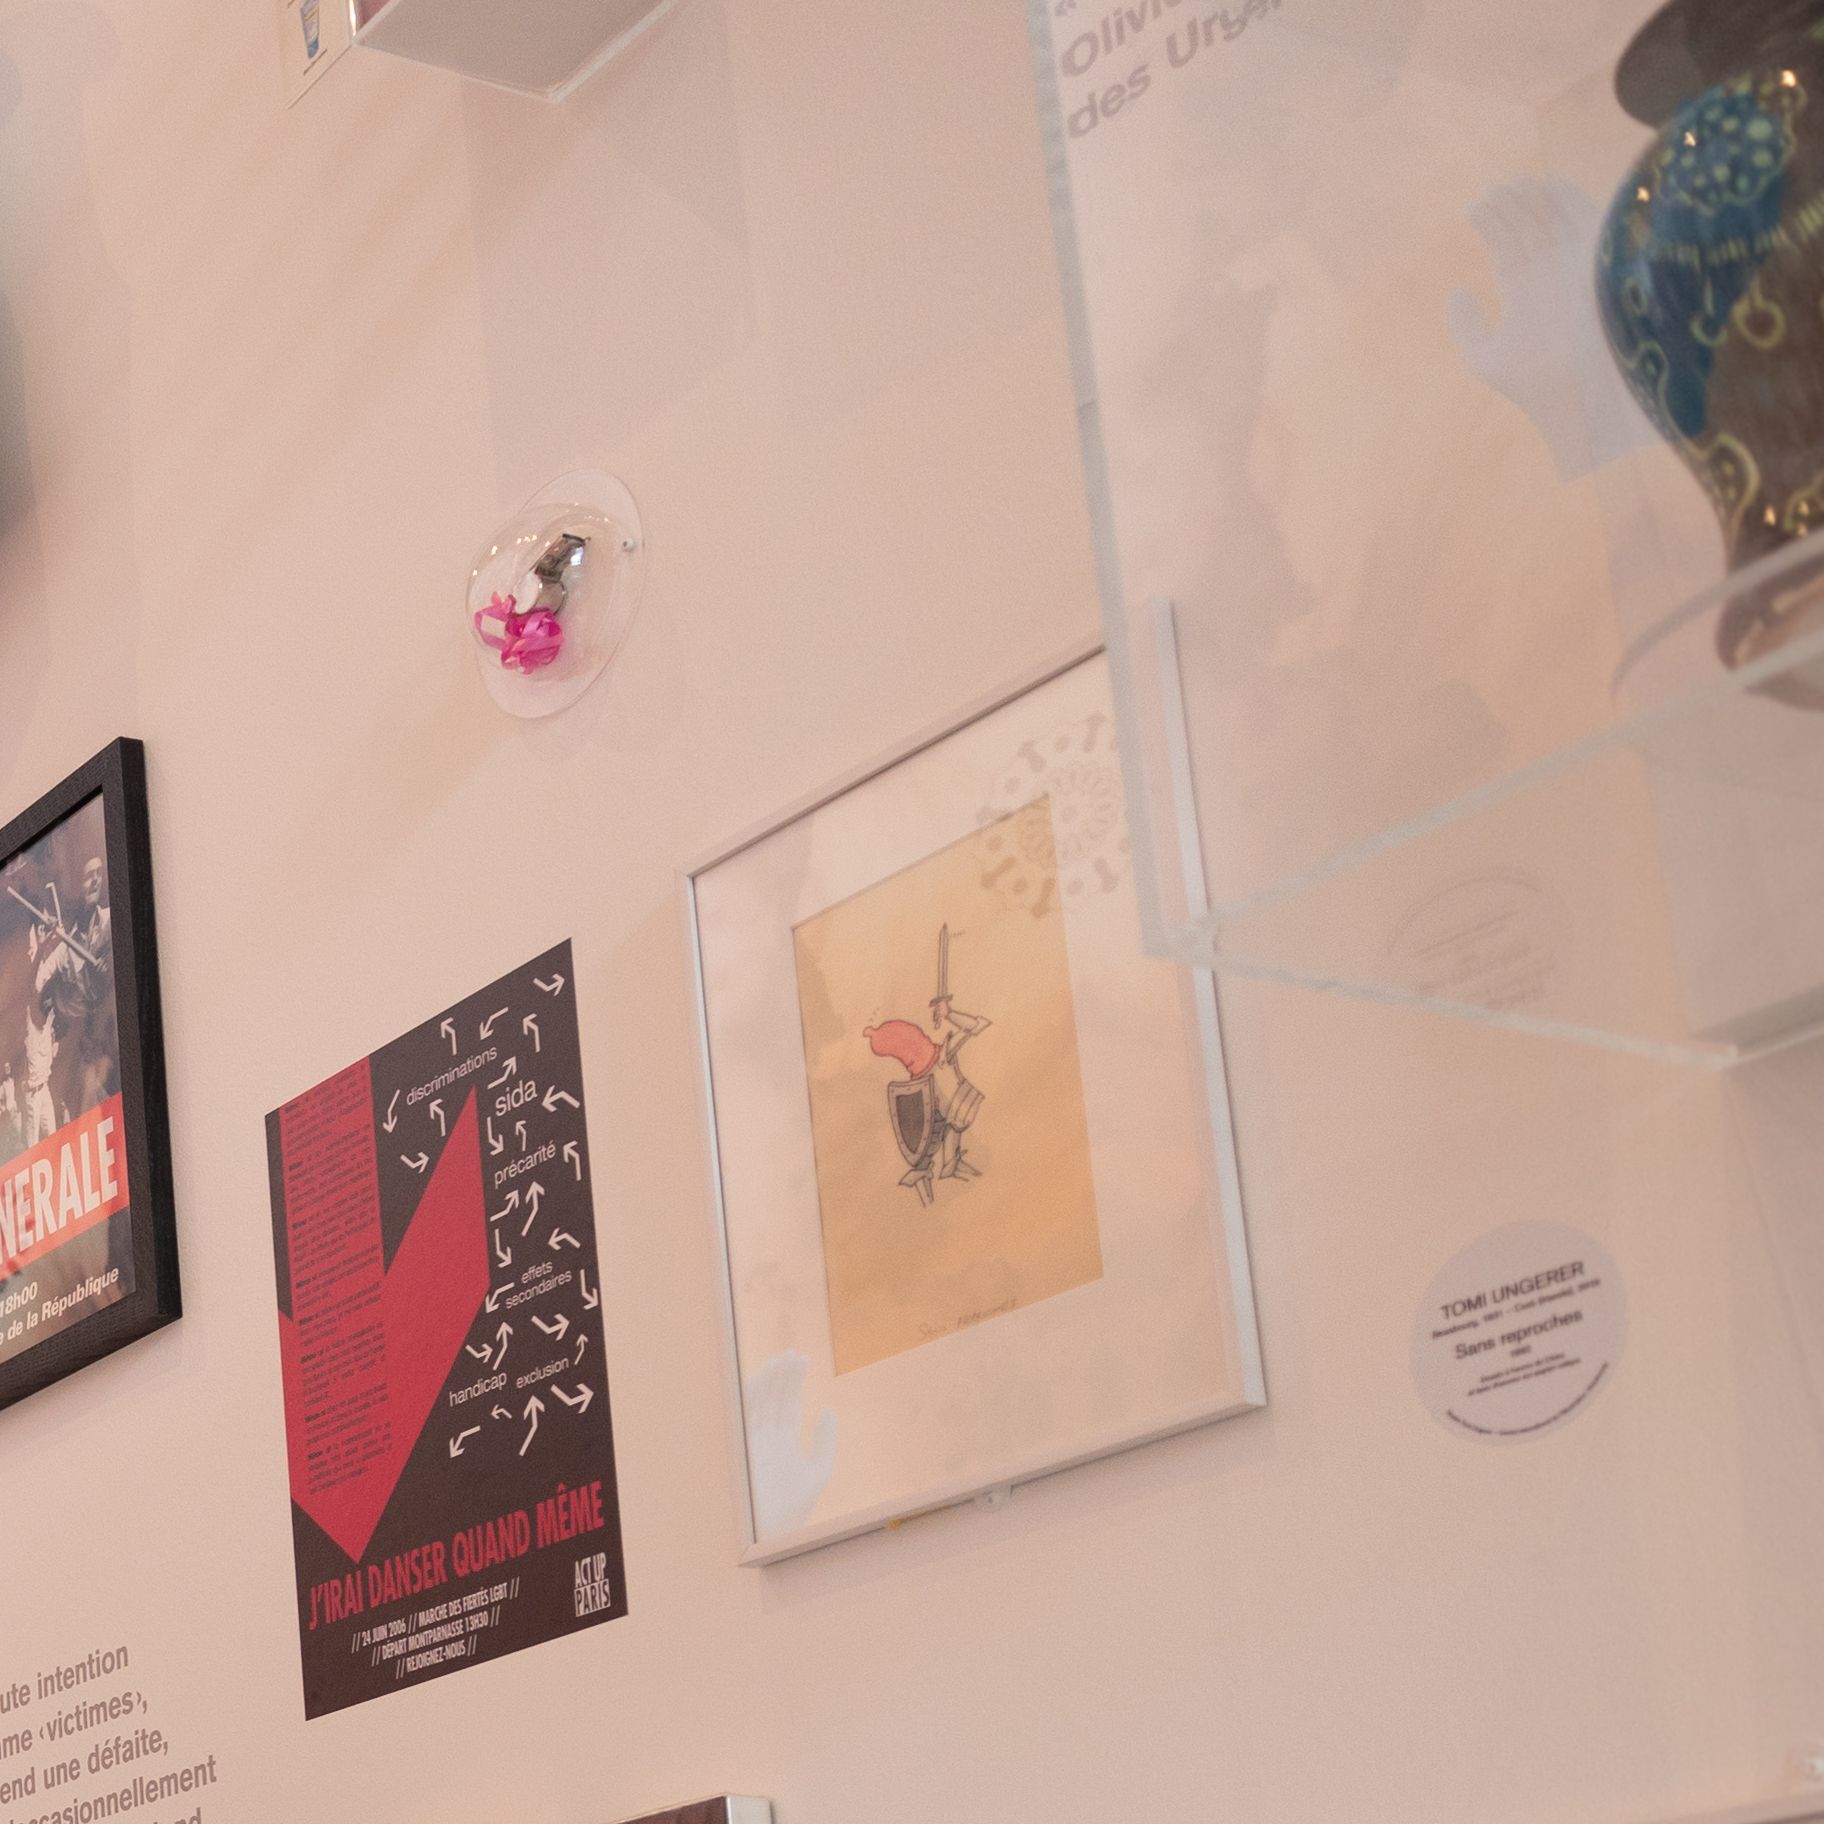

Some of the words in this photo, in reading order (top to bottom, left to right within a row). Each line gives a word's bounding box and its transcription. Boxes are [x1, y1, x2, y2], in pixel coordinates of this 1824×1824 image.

[1066, 63, 1151, 139] des
[405, 1046, 498, 1106] discriminations
[494, 1079, 539, 1117] sida
[493, 1139, 557, 1190] précarité
[505, 1269, 573, 1310] secondaires
[520, 1260, 553, 1284] effets
[1440, 1292, 1488, 1320] TOMI
[1492, 1260, 1585, 1304] UNGERER
[7, 1319, 24, 1340] de
[27, 1308, 39, 1331] la
[41, 1266, 120, 1322] République
[1455, 1333, 1496, 1360] Sans
[1500, 1309, 1584, 1346] reproches
[448, 1371, 508, 1408] handicap
[515, 1357, 570, 1389] exclusion
[367, 1540, 448, 1609] DANSER
[452, 1509, 531, 1579] QUAND
[536, 1479, 604, 1549] MÊME
[574, 1555, 594, 1589] ACT
[594, 1551, 607, 1581] UP
[361, 1630, 372, 1648] 24
[372, 1623, 388, 1644] JUIN
[388, 1618, 407, 1639] 2006
[418, 1604, 448, 1628] MARCHE
[448, 1599, 461, 1618] DES
[462, 1586, 489, 1614] FIERTÉS
[489, 1581, 508, 1602] LGBT
[574, 1580, 611, 1616] PARIS
[406, 1639, 466, 1672] REJOIGNEZ-NOUS
[407, 1621, 464, 1653] MONTPARNASSE
[465, 1614, 489, 1633] 13H30
[36, 1645, 129, 1700] intention
